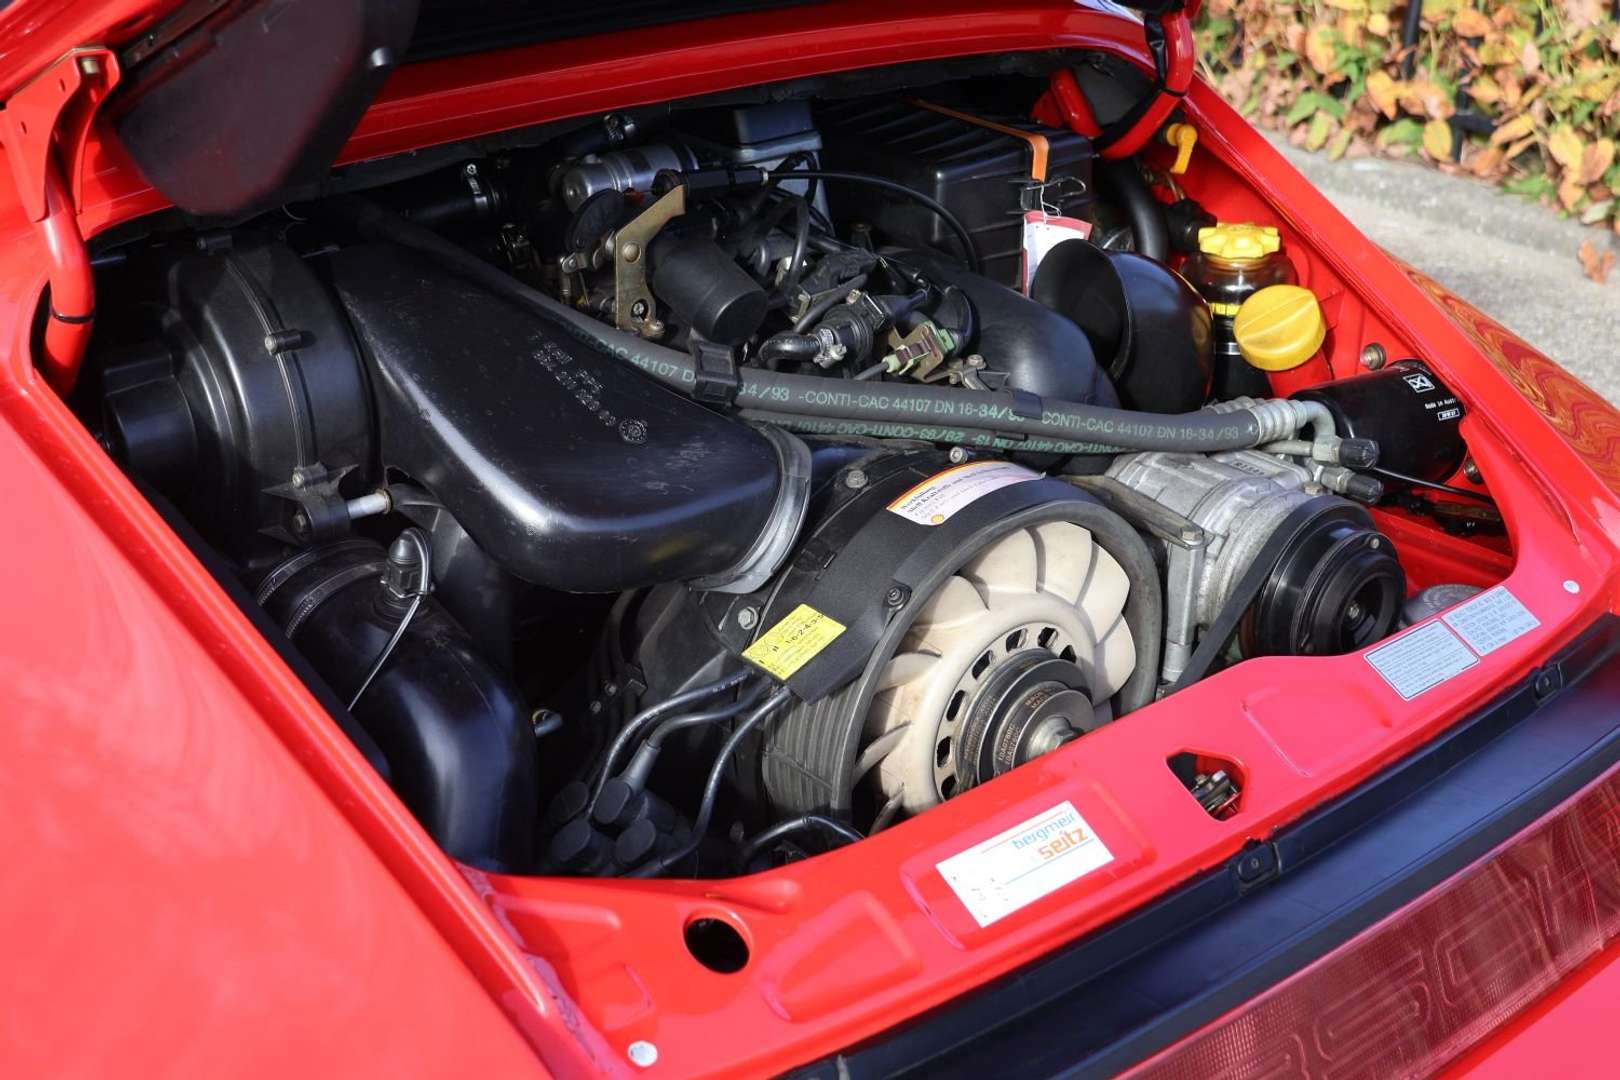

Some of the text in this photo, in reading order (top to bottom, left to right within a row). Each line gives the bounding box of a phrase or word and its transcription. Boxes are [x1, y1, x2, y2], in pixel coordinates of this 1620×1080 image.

[630, 353, 679, 378] 44107
[891, 396, 931, 413] 44107
[933, 399, 956, 415] DN
[1116, 421, 1154, 437] 44107
[1155, 426, 1177, 440] DN
